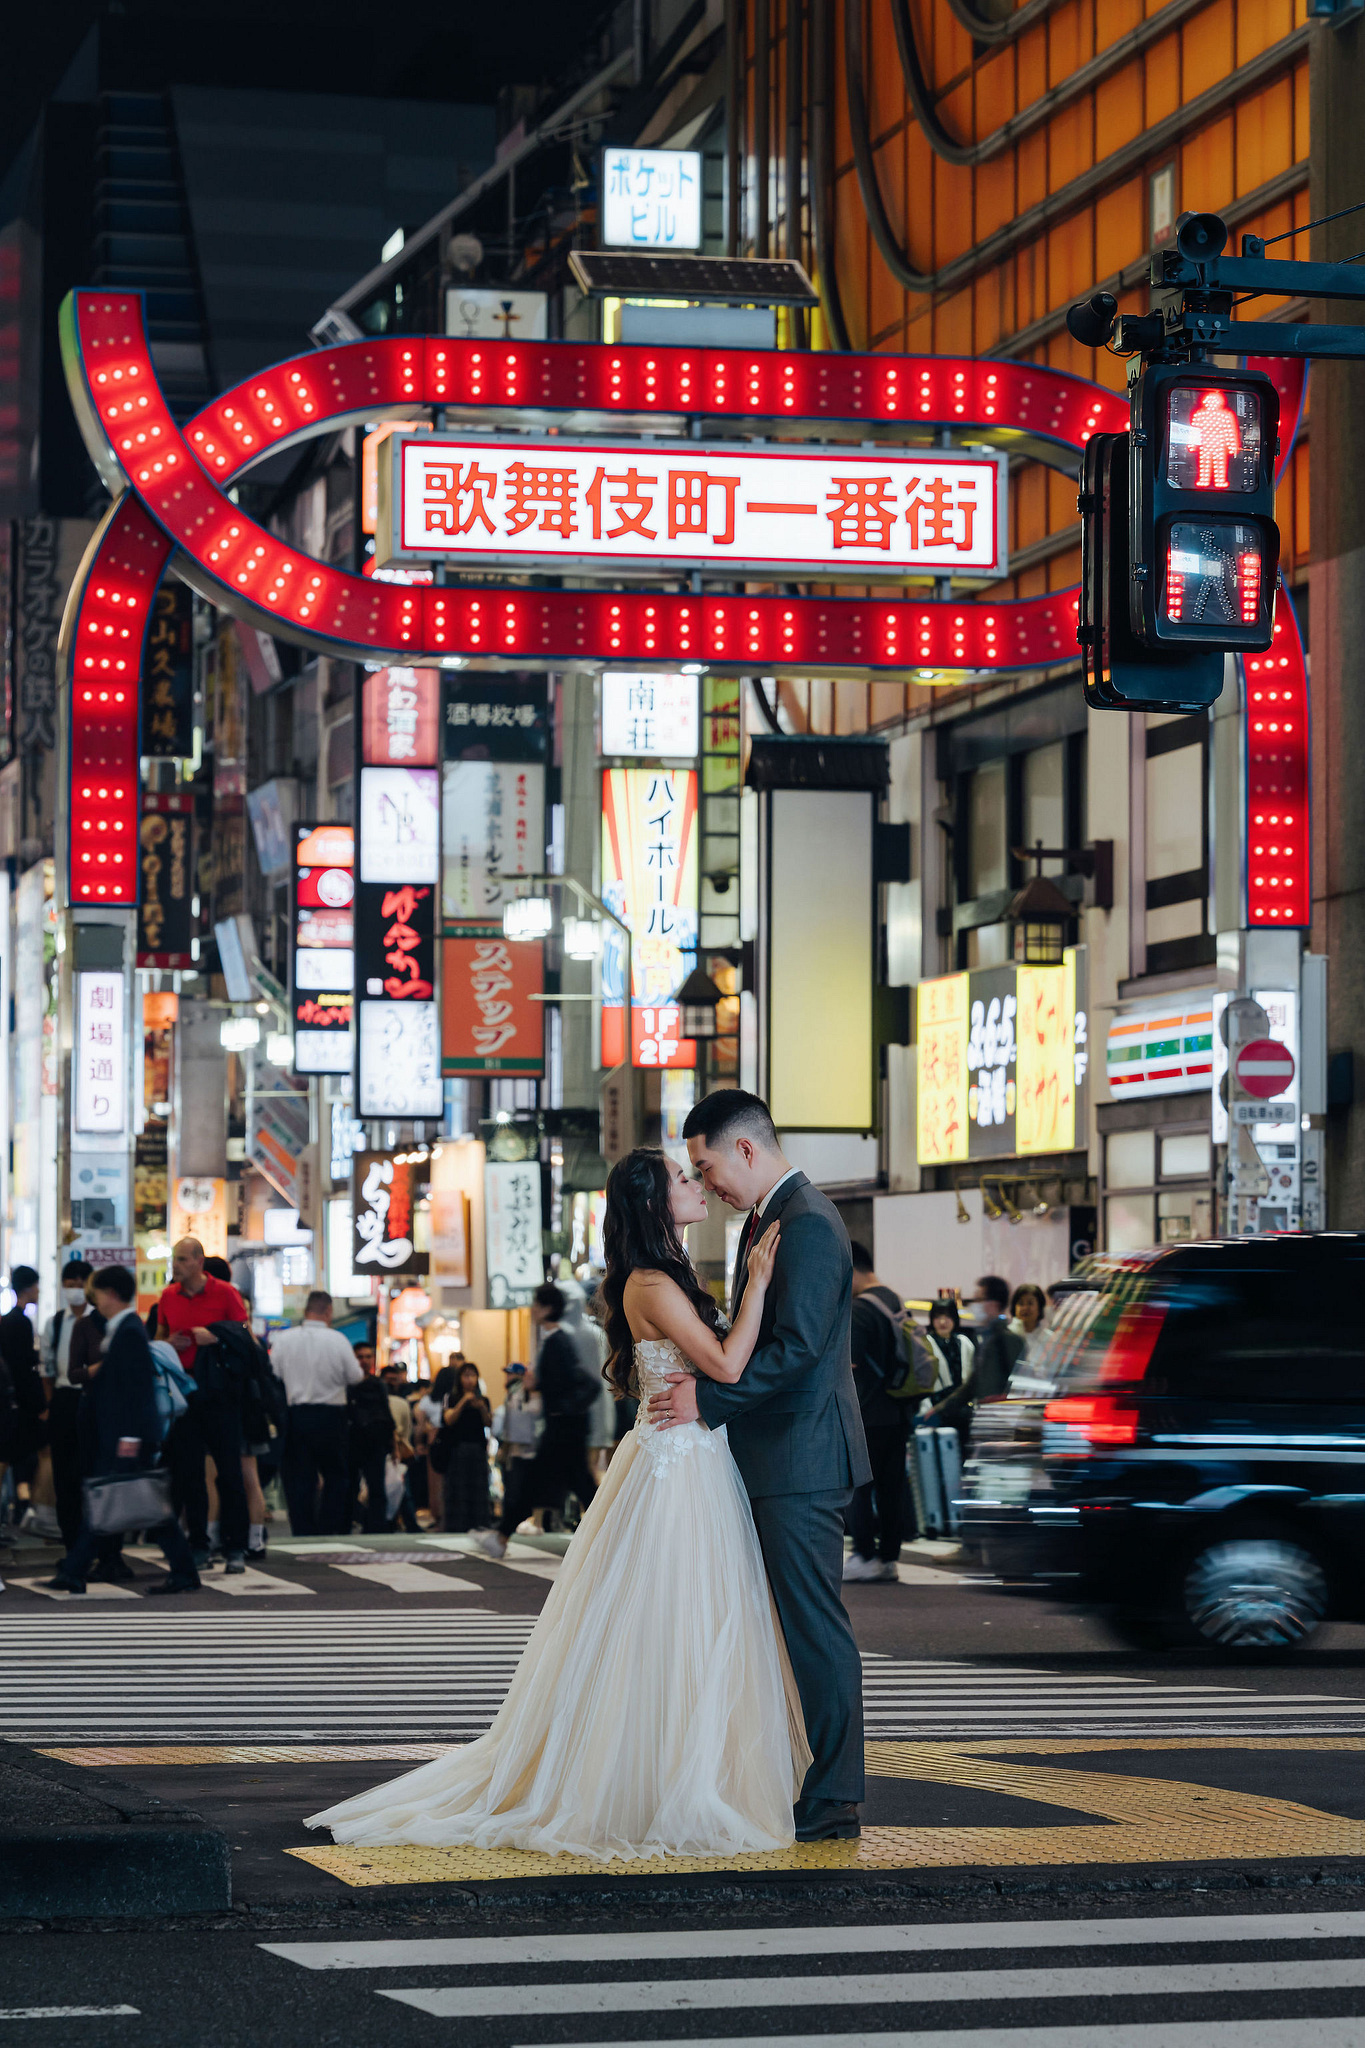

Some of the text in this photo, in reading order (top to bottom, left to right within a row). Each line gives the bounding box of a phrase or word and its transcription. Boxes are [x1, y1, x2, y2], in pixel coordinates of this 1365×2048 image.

[610, 157, 694, 199] ポケット
[631, 202, 676, 242] ビル
[424, 460, 977, 552] 歌舞伎町一番街
[648, 779, 675, 935] ハイボール
[469, 942, 516, 1055] ステップ
[641, 1008, 679, 1034] 1F
[89, 986, 114, 1117] 劇場通り
[639, 1039, 679, 1065] 2F
